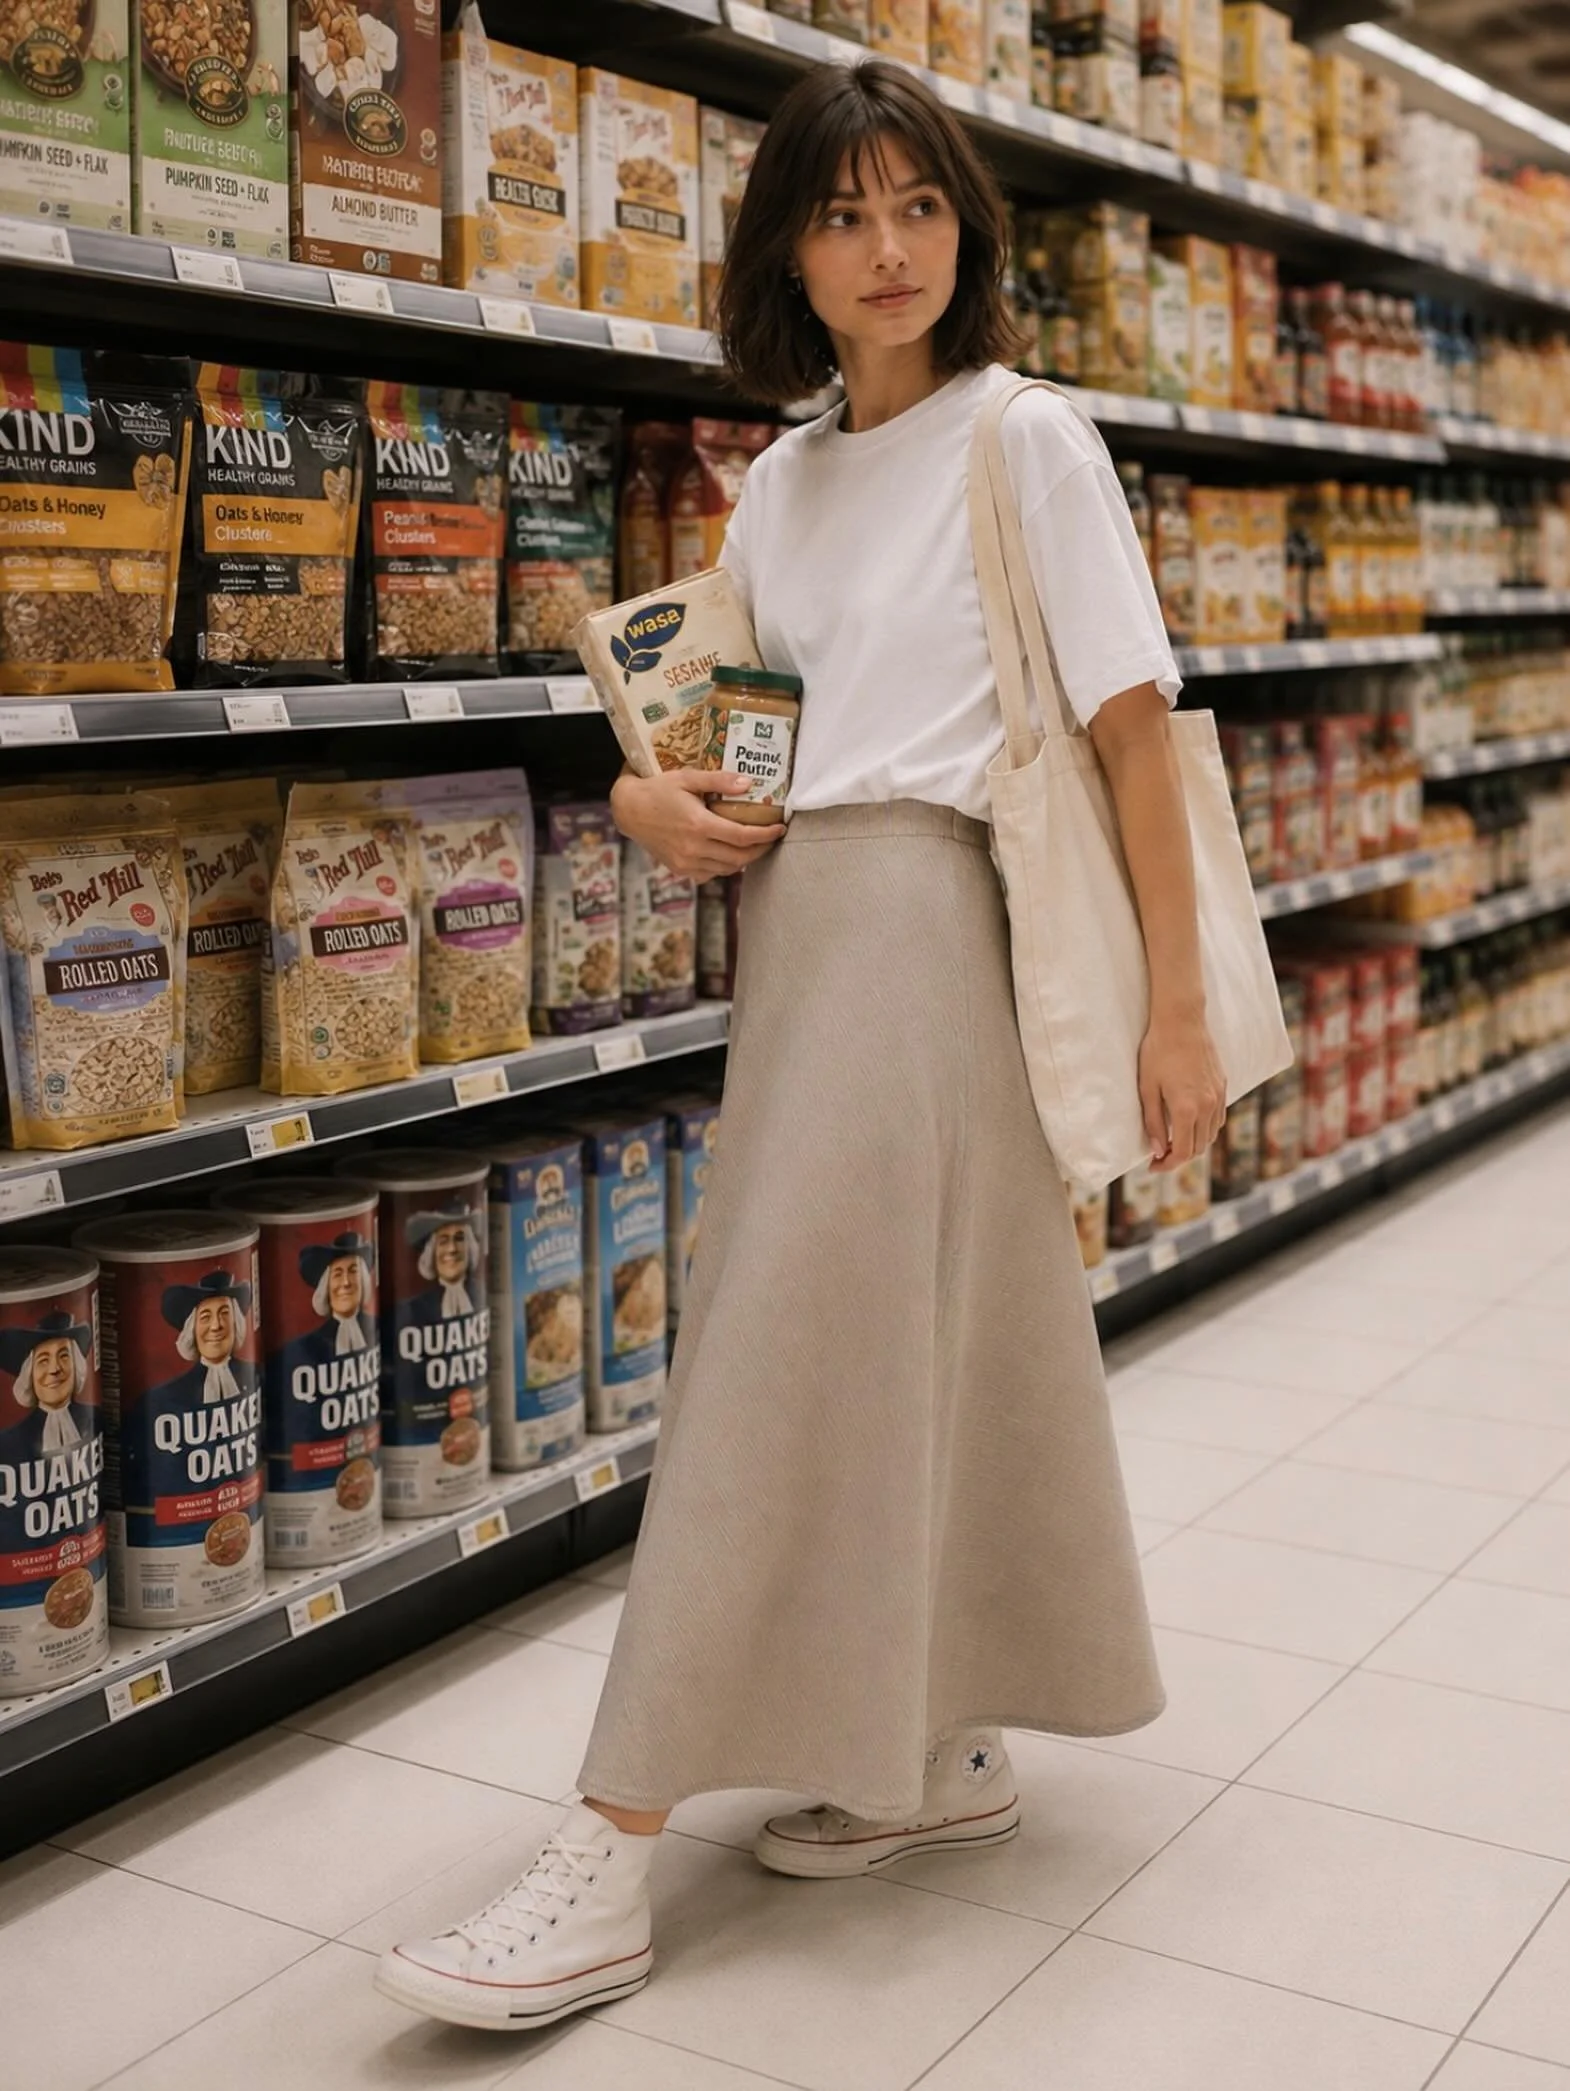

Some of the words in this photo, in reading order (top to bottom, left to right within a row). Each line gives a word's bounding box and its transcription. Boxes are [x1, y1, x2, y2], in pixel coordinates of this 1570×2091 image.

[46, 146, 73, 168] SEED
[166, 167, 212, 192] PUMPKIN
[215, 176, 238, 197] SEED
[332, 195, 376, 218] ALMOND
[380, 203, 419, 227] BUTTER
[206, 424, 293, 469] KIND
[376, 439, 447, 477] KIND
[208, 468, 255, 484] HEALTHY
[509, 452, 573, 486] KIND
[0, 496, 38, 513] Oats
[57, 498, 106, 520] Honey
[216, 504, 248, 521] Oats
[628, 608, 681, 639] wasa
[319, 854, 351, 896] Red
[57, 876, 102, 927] Red
[193, 924, 241, 953] ROLLED
[324, 929, 370, 952] ROLLED
[370, 921, 402, 946] OATS
[59, 960, 119, 990] ROLLED
[121, 953, 159, 981] OATS
[426, 1345, 488, 1390] OATS
[321, 1381, 380, 1431] OATS
[187, 1433, 257, 1483] OATS
[24, 1481, 98, 1539] OATS
